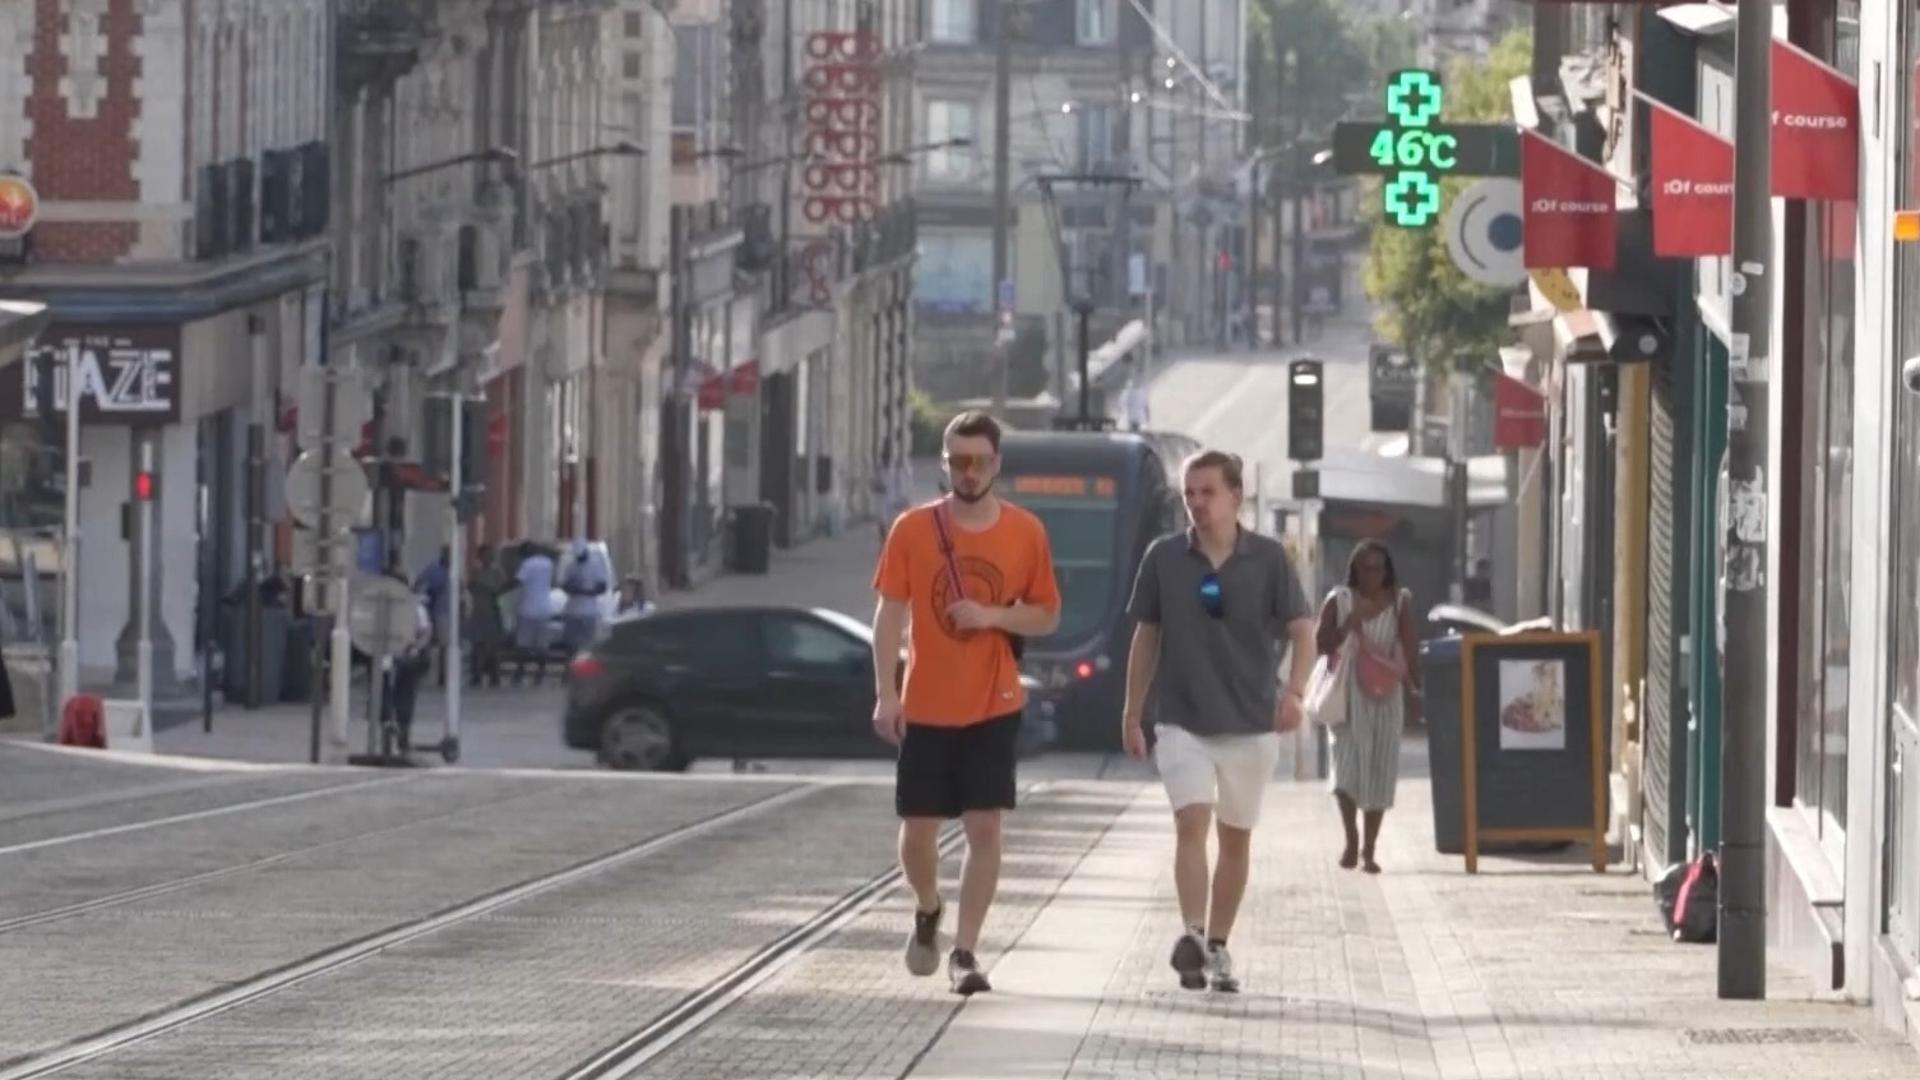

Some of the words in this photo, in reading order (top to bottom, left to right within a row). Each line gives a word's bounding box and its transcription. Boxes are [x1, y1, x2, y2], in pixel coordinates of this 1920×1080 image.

[1772, 110, 1780, 126] f
[1783, 113, 1848, 128] course
[1369, 128, 1457, 169] 46°C
[1693, 182, 1736, 195] cour
[1560, 201, 1609, 213] course
